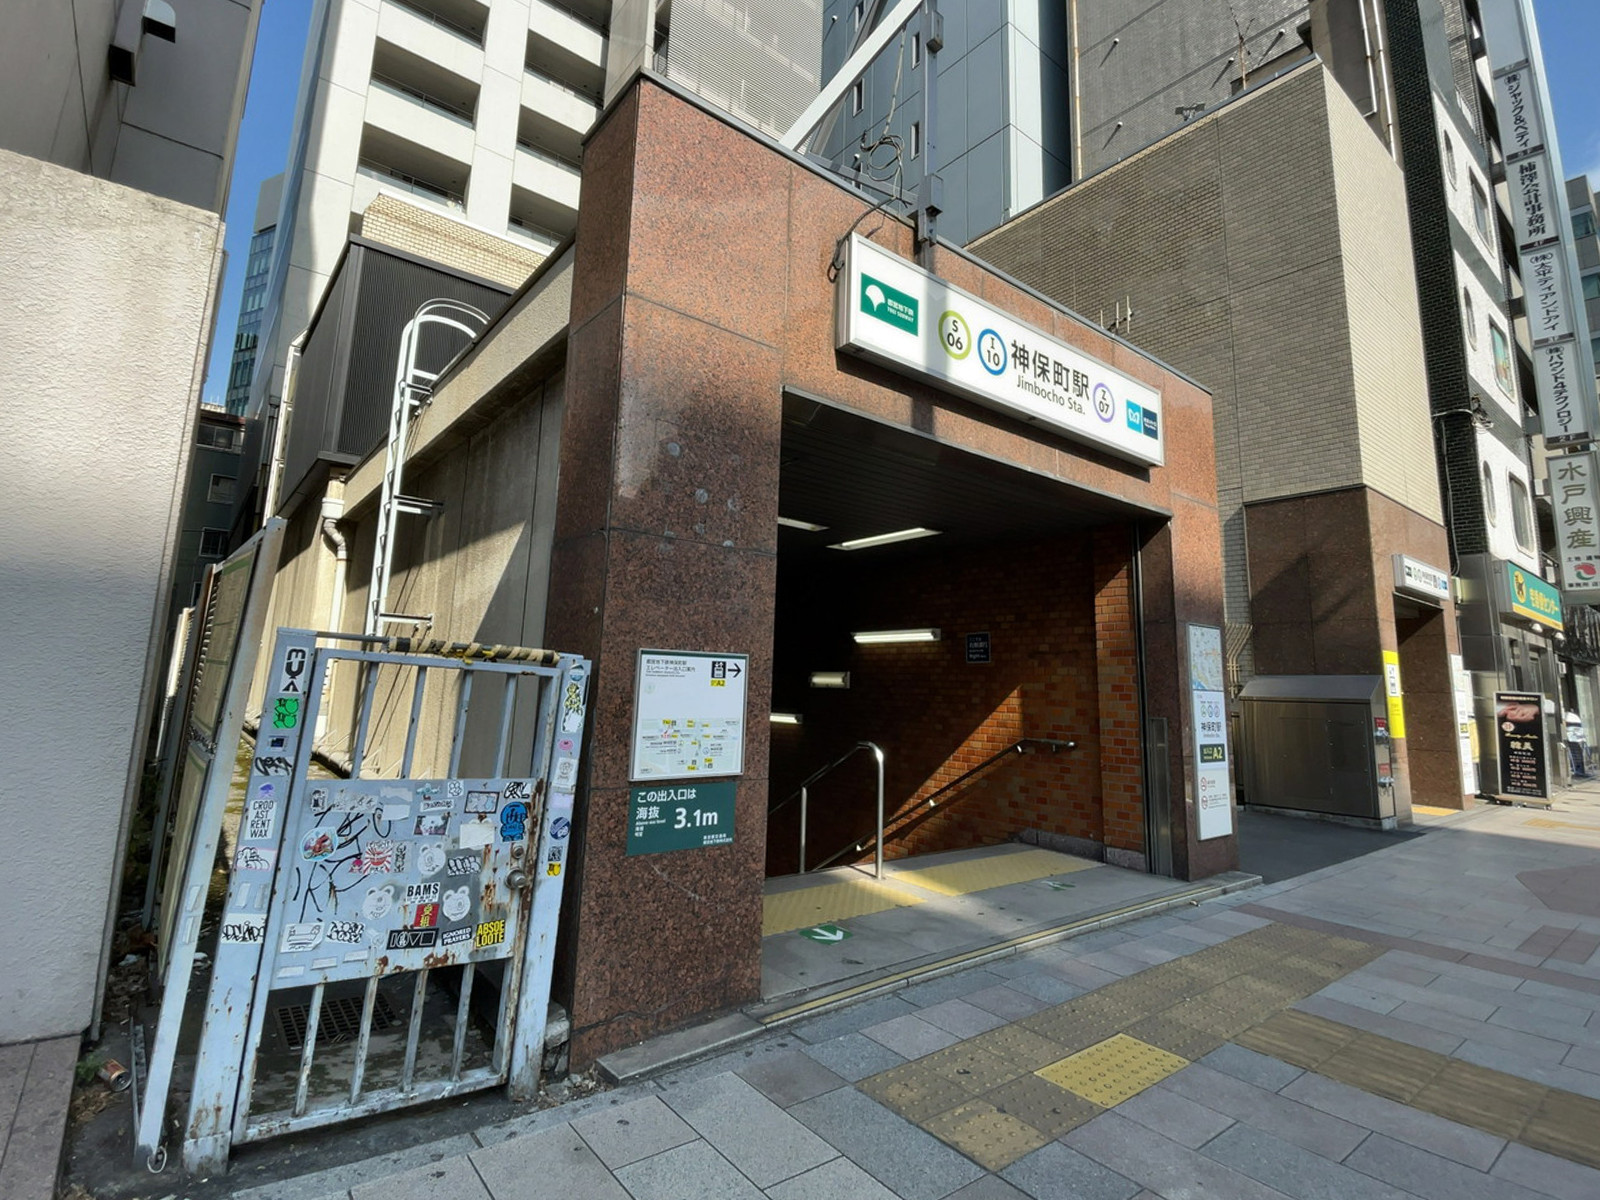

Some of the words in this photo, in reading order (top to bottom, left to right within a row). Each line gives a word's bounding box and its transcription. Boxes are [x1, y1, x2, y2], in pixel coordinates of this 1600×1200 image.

[952, 319, 959, 333] S
[946, 332, 963, 351] 06
[990, 337, 995, 349] I
[986, 350, 1000, 366] 10
[1011, 339, 1090, 401] 神保町駅
[1017, 375, 1065, 406] Jimbocho
[1068, 396, 1086, 415] Sta.
[1101, 389, 1107, 401] Z
[1098, 401, 1109, 414] 07
[1558, 461, 1597, 549] 水戸興産
[1212, 746, 1223, 759] A2
[637, 788, 697, 804] この出入口は
[635, 806, 660, 820] 海抜
[674, 807, 718, 829] 3.1m
[250, 828, 269, 839] WAX
[407, 883, 439, 898] BAMS
